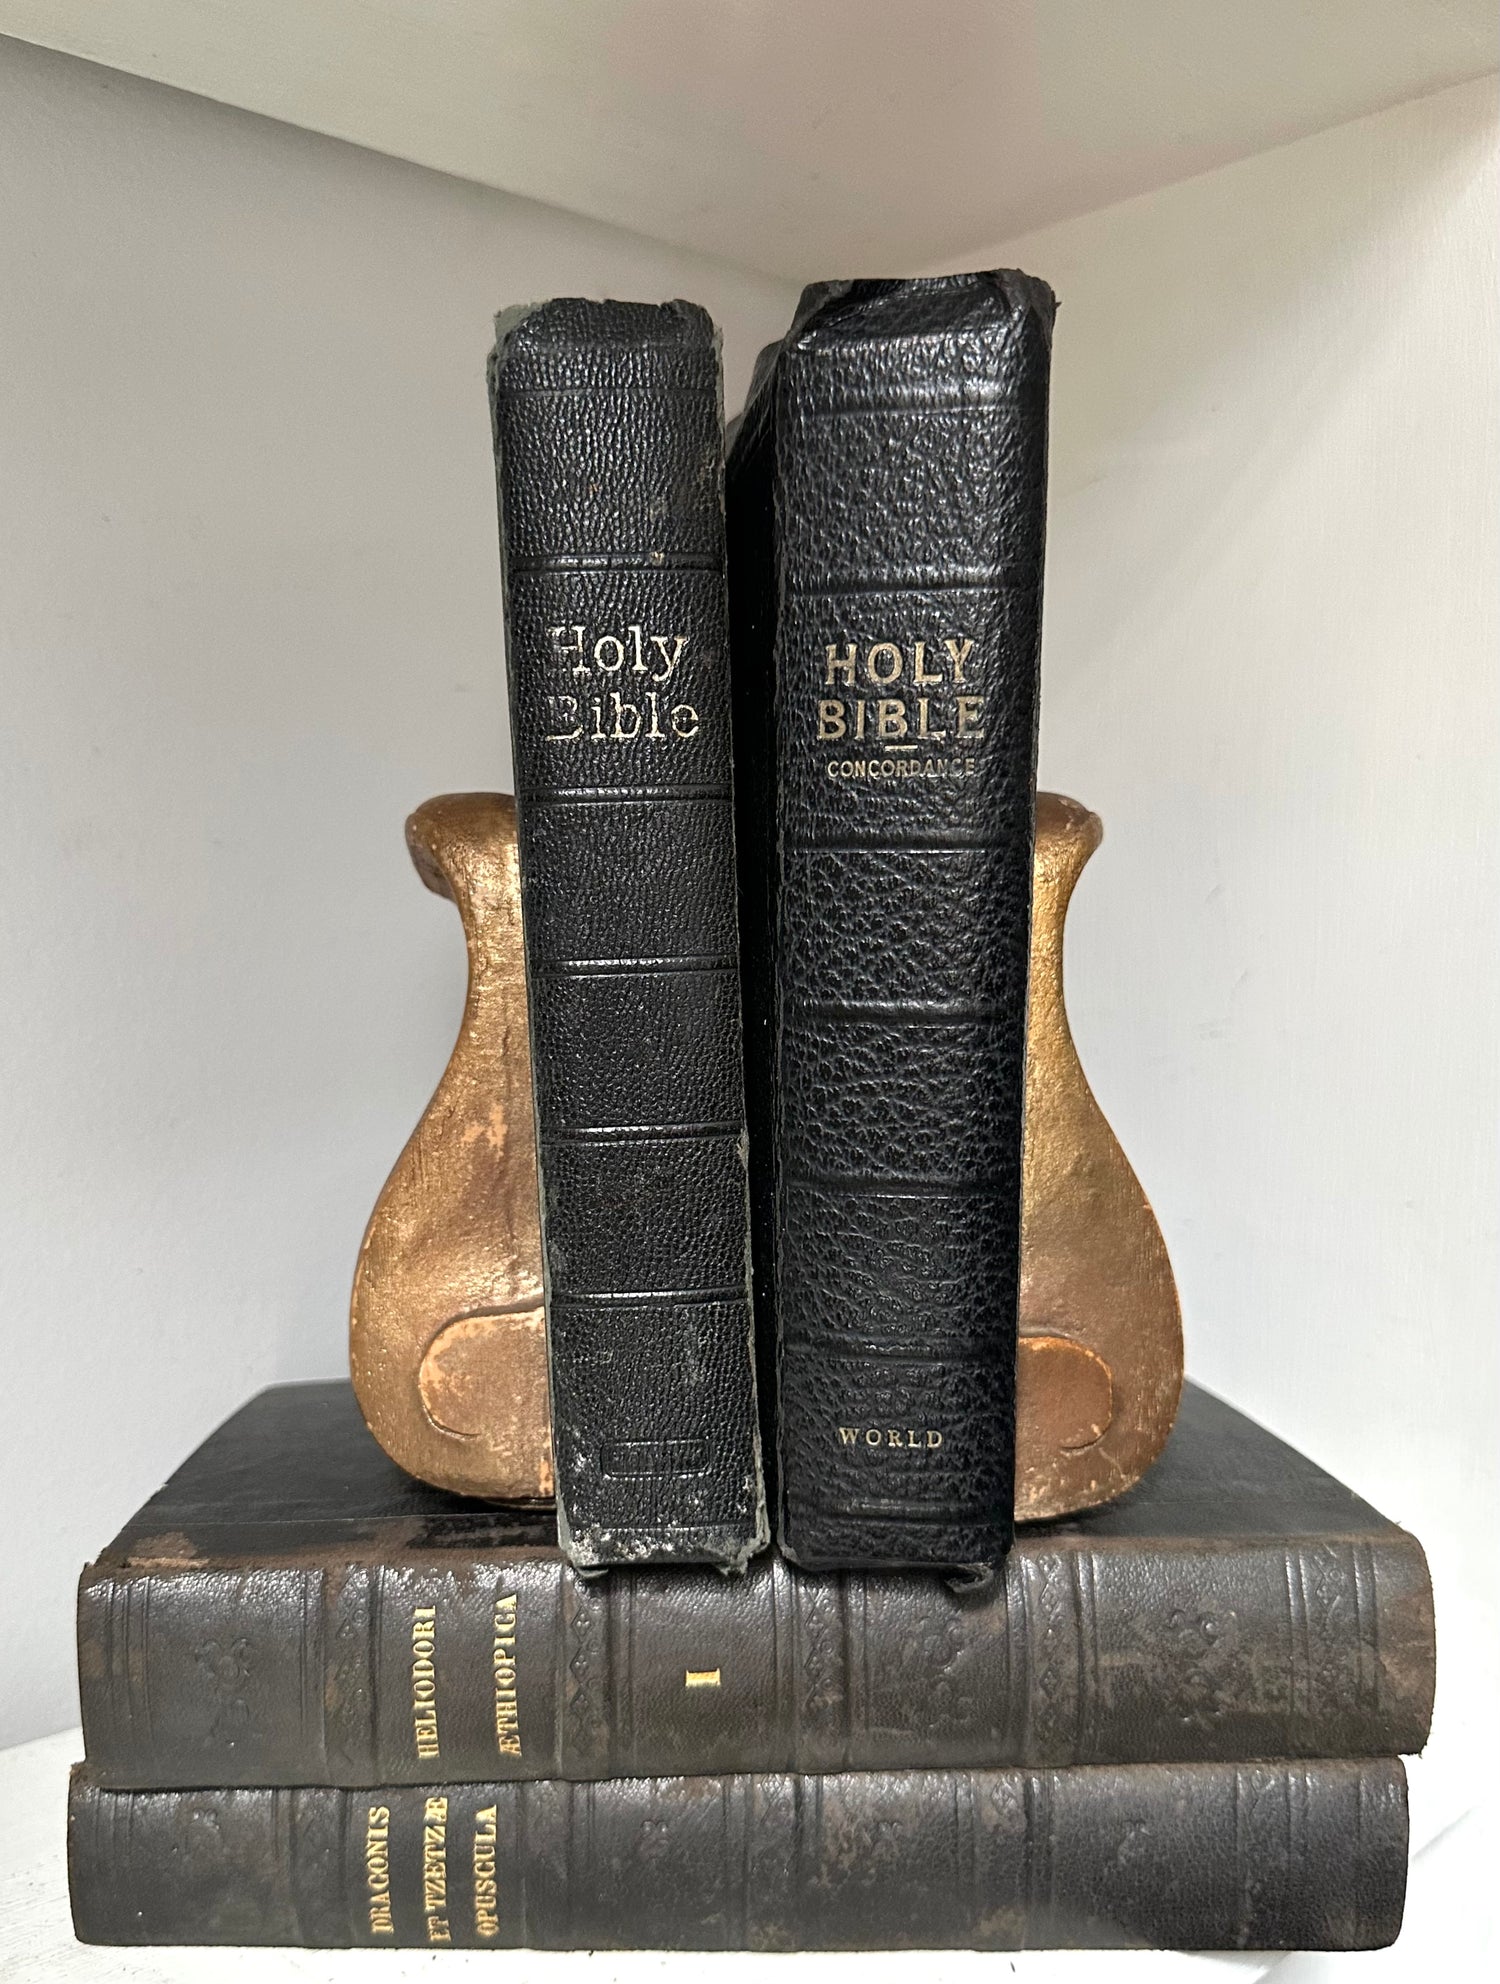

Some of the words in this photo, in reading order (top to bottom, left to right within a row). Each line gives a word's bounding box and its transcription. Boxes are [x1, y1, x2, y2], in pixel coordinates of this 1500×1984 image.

[548, 625, 690, 682] Holy
[825, 638, 975, 686] HOLY
[817, 696, 985, 740] BIBLE
[827, 757, 976, 779] CONCORDANCE
[838, 1426, 944, 1448] WORLD
[412, 1605, 440, 1759] HELIODORI
[494, 1593, 523, 1758] ÆTHIOPICA
[473, 1803, 500, 1938] OPUSCULA
[427, 1915, 451, 1942] ET
